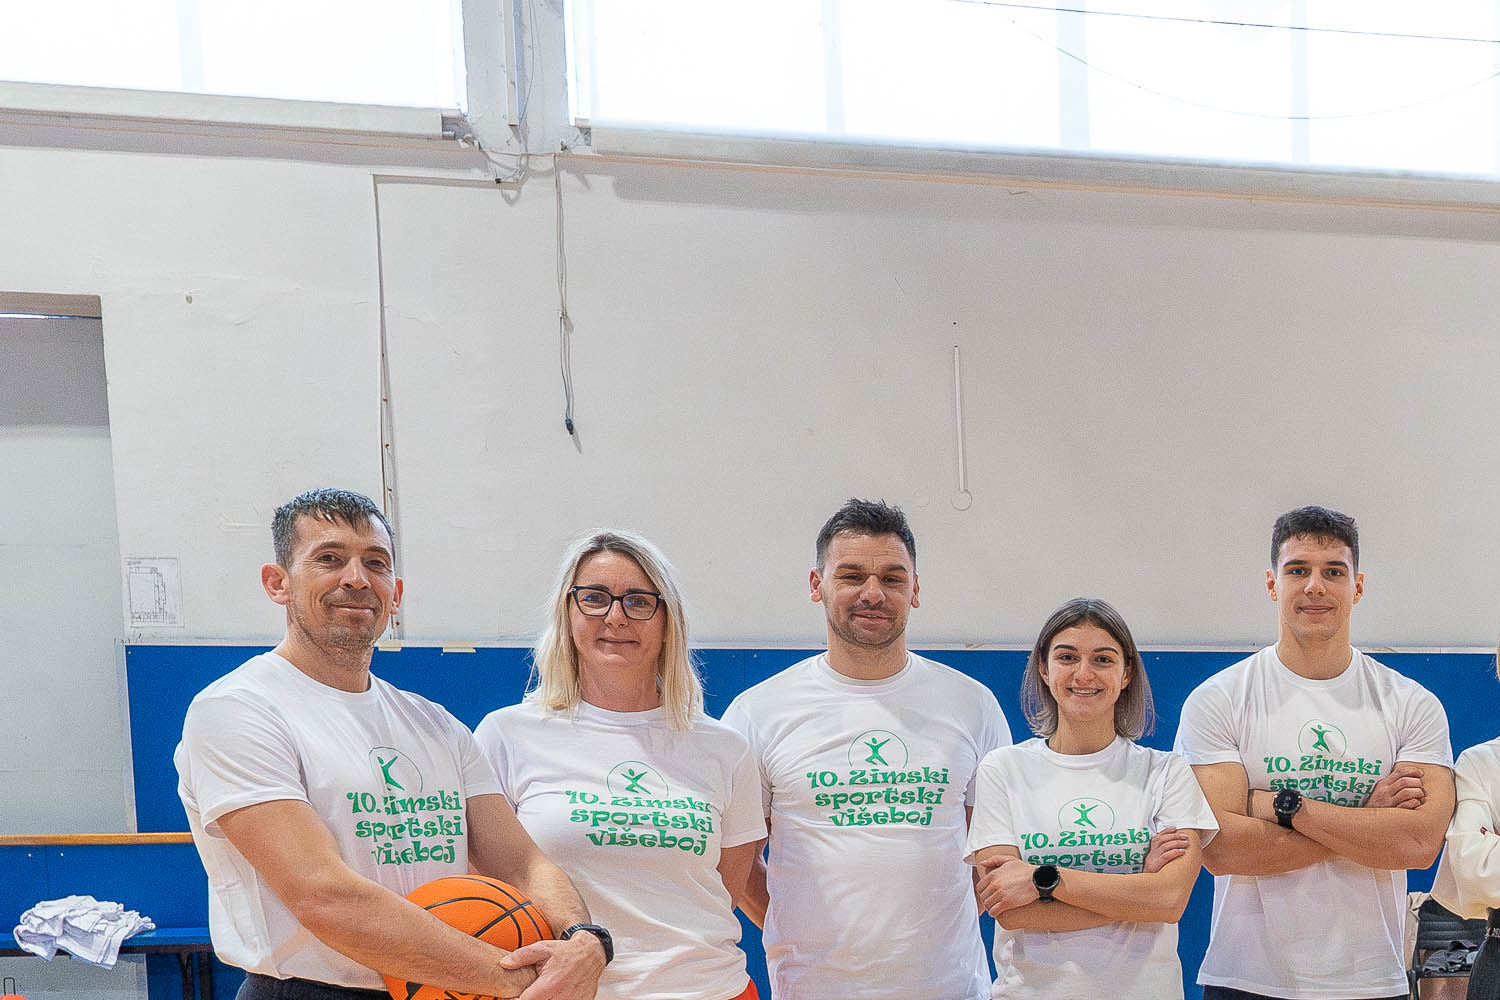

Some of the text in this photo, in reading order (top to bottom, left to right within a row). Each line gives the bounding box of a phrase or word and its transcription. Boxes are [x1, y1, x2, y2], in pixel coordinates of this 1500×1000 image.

[1264, 754, 1382, 775] 10. Zimski
[807, 766, 950, 788] 10. Zimski
[346, 791, 382, 813] 10.
[565, 789, 712, 813] 10. Zimski
[815, 786, 945, 809] sportski
[569, 808, 715, 834] sportski
[829, 805, 934, 826] višeboj
[355, 815, 464, 842] sprtski
[1020, 827, 1151, 850] 10. Zimski
[585, 826, 708, 856] višeboj
